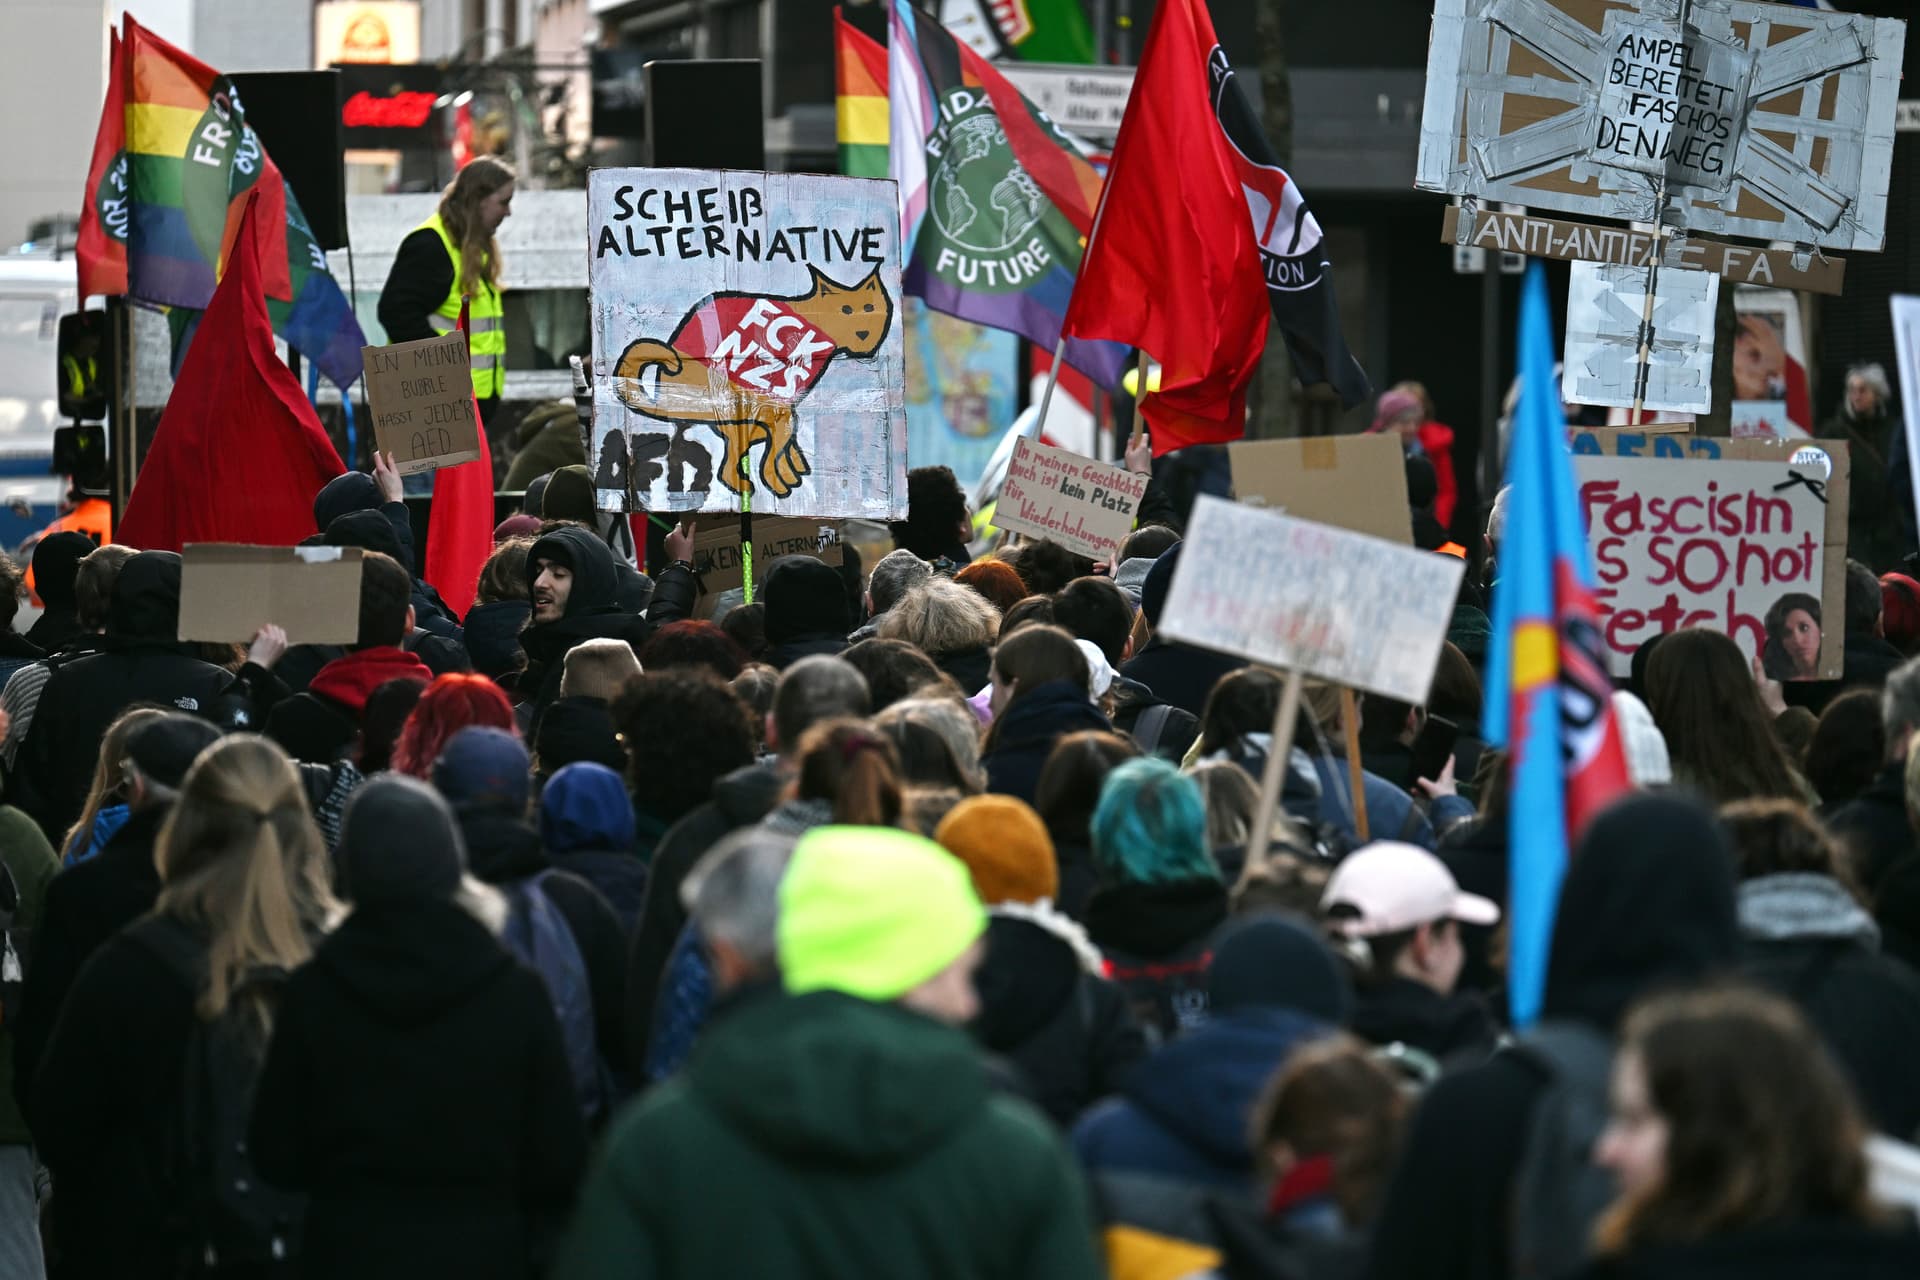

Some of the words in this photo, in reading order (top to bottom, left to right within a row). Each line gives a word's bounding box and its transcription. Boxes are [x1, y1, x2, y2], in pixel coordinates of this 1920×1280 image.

[1617, 34, 1701, 73] AMPEL
[1609, 58, 1734, 110] BEREITET
[1630, 93, 1732, 139] FASCHOS
[1596, 116, 1658, 159] DEN
[1660, 131, 1725, 176] WEG
[597, 225, 885, 263] ALTERNATIVE
[936, 238, 1051, 287] FUTURE
[1722, 248, 1774, 283] FA
[739, 299, 835, 370] FCK
[372, 351, 399, 374] IN
[414, 341, 466, 368] MEINER
[712, 330, 809, 398] NZS
[401, 376, 448, 399] BUBBLE
[378, 410, 413, 428] HASST
[411, 428, 451, 460] AFD
[1033, 452, 1079, 477] meinem
[1005, 479, 1024, 501] für
[1010, 459, 1036, 482] buch
[1041, 471, 1058, 490] ist
[1059, 476, 1086, 501] kein
[1091, 487, 1132, 515] Platz
[1019, 498, 1118, 550] Wiederholungen
[706, 542, 754, 573] KEIN
[761, 533, 843, 561] ALTERNATIVE
